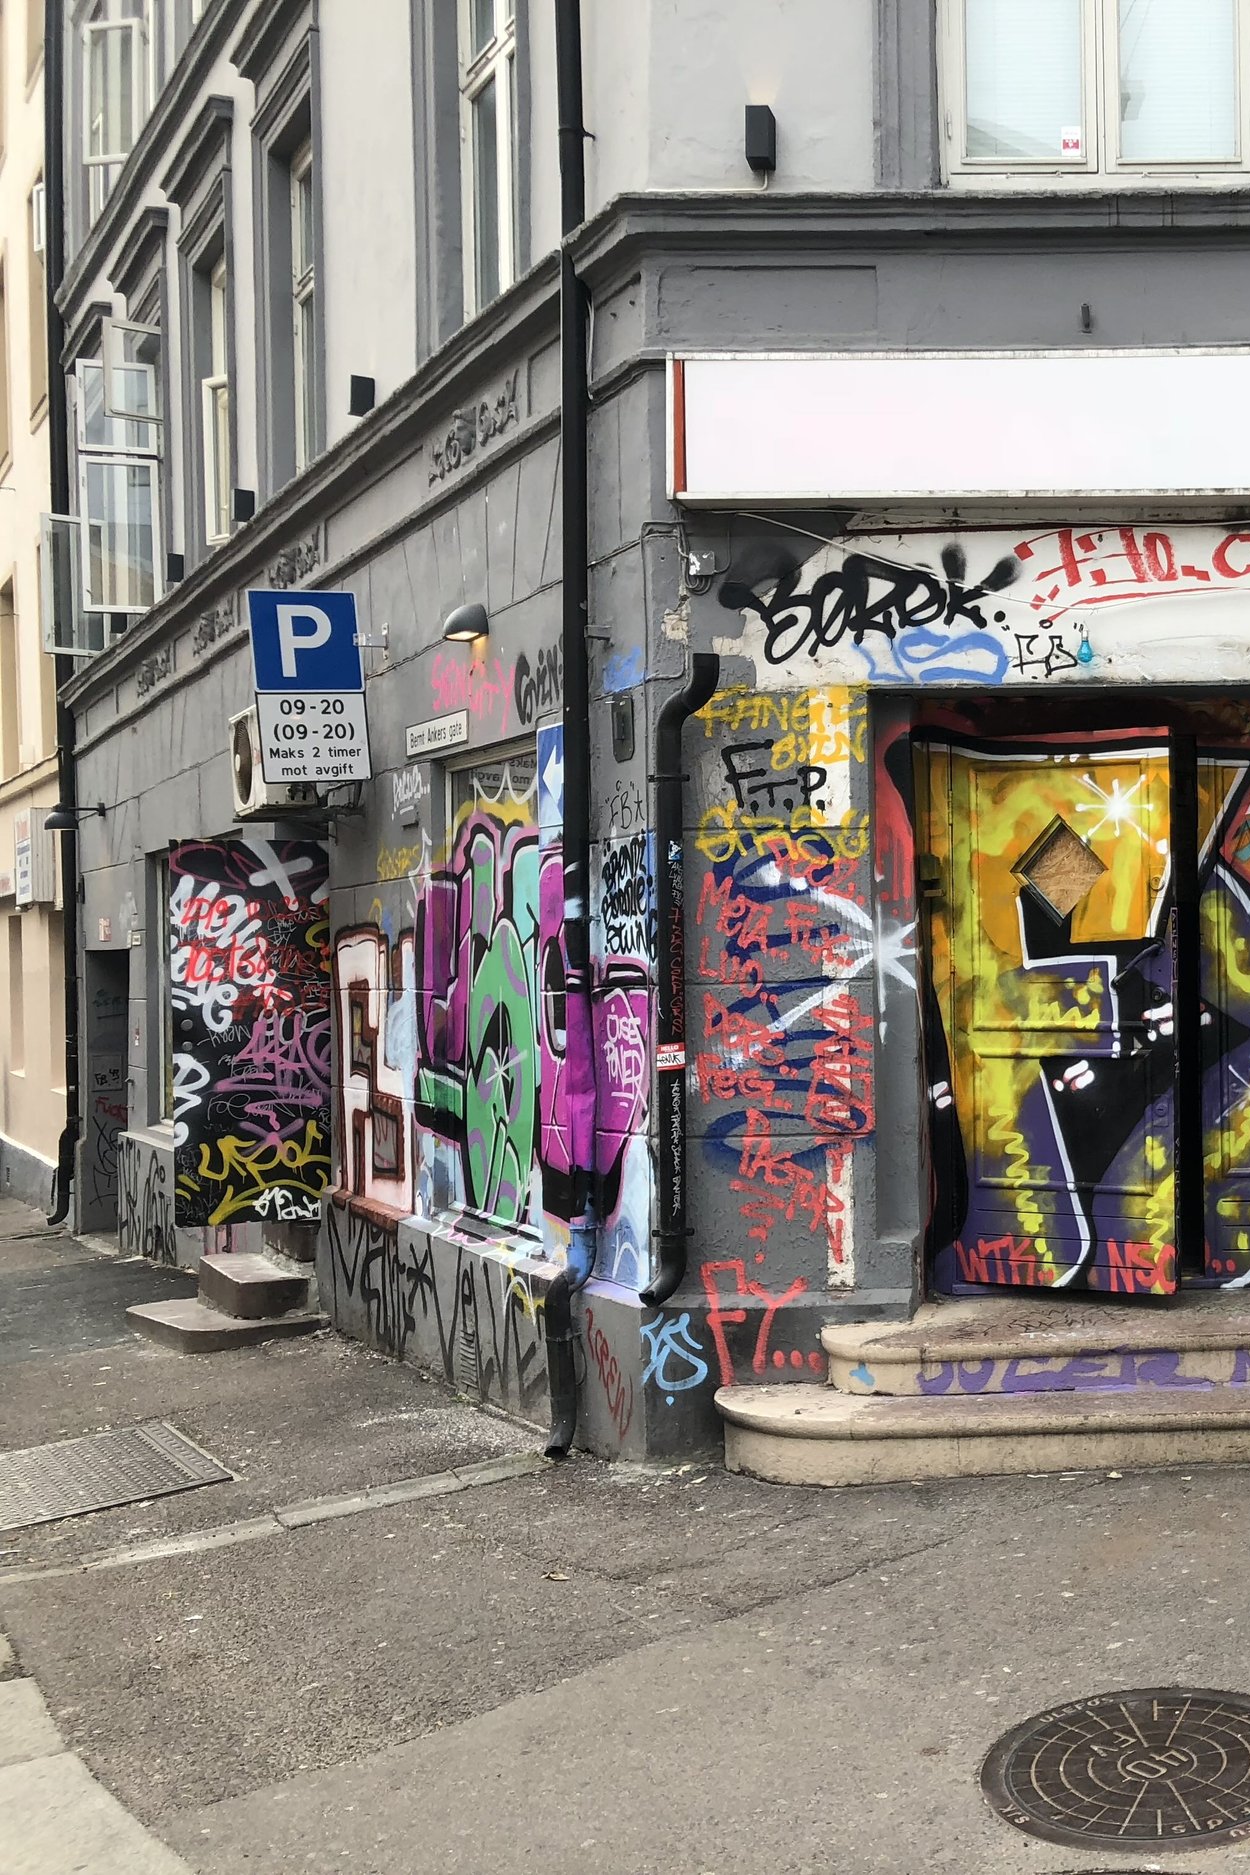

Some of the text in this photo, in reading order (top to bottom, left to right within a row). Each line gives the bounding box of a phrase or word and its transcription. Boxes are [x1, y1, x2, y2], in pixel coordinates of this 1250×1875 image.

[276, 604, 332, 678] P
[410, 720, 462, 748] Bernt Ankers gate
[269, 746, 361, 759] Maks 2 timer
[281, 763, 354, 777] mot avgift
